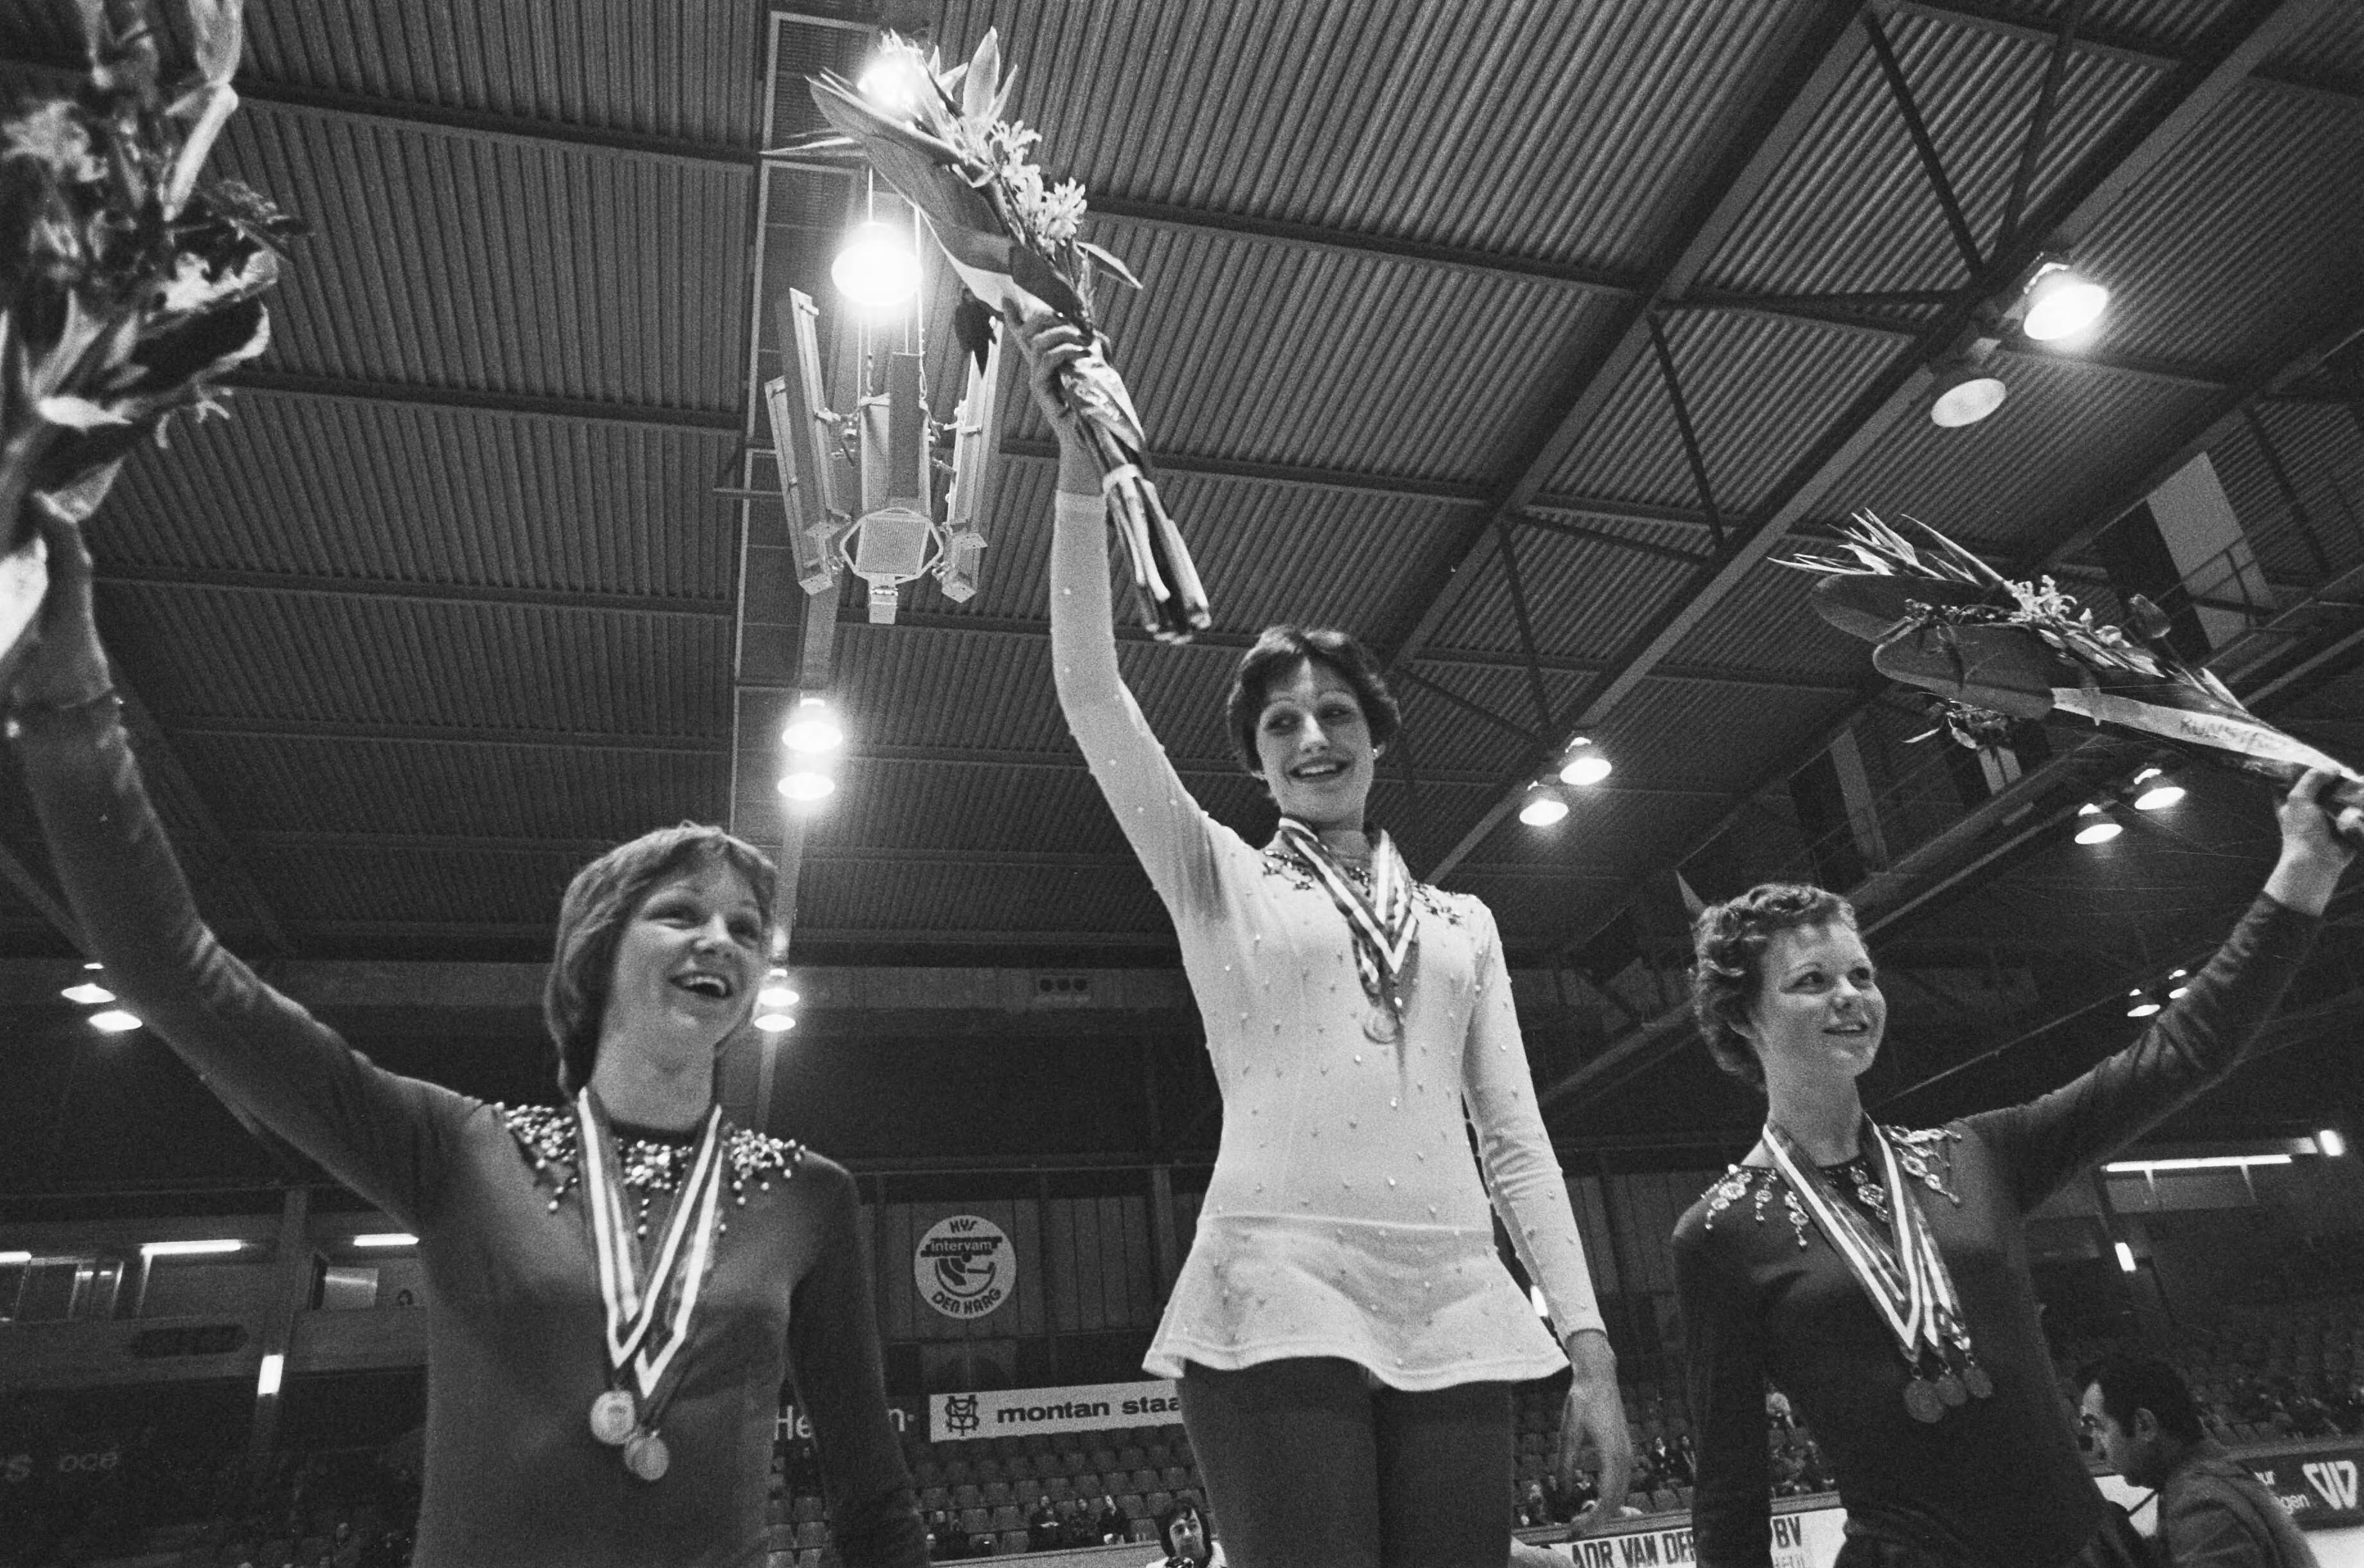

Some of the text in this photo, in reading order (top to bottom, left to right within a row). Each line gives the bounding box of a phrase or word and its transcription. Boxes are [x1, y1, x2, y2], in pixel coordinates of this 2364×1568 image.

[931, 1288, 1001, 1314] DEN HAAG
[997, 1396, 1180, 1424] montan staa
[1773, 1516, 1801, 1548] BV
[1619, 1535, 1659, 1567] VAN
